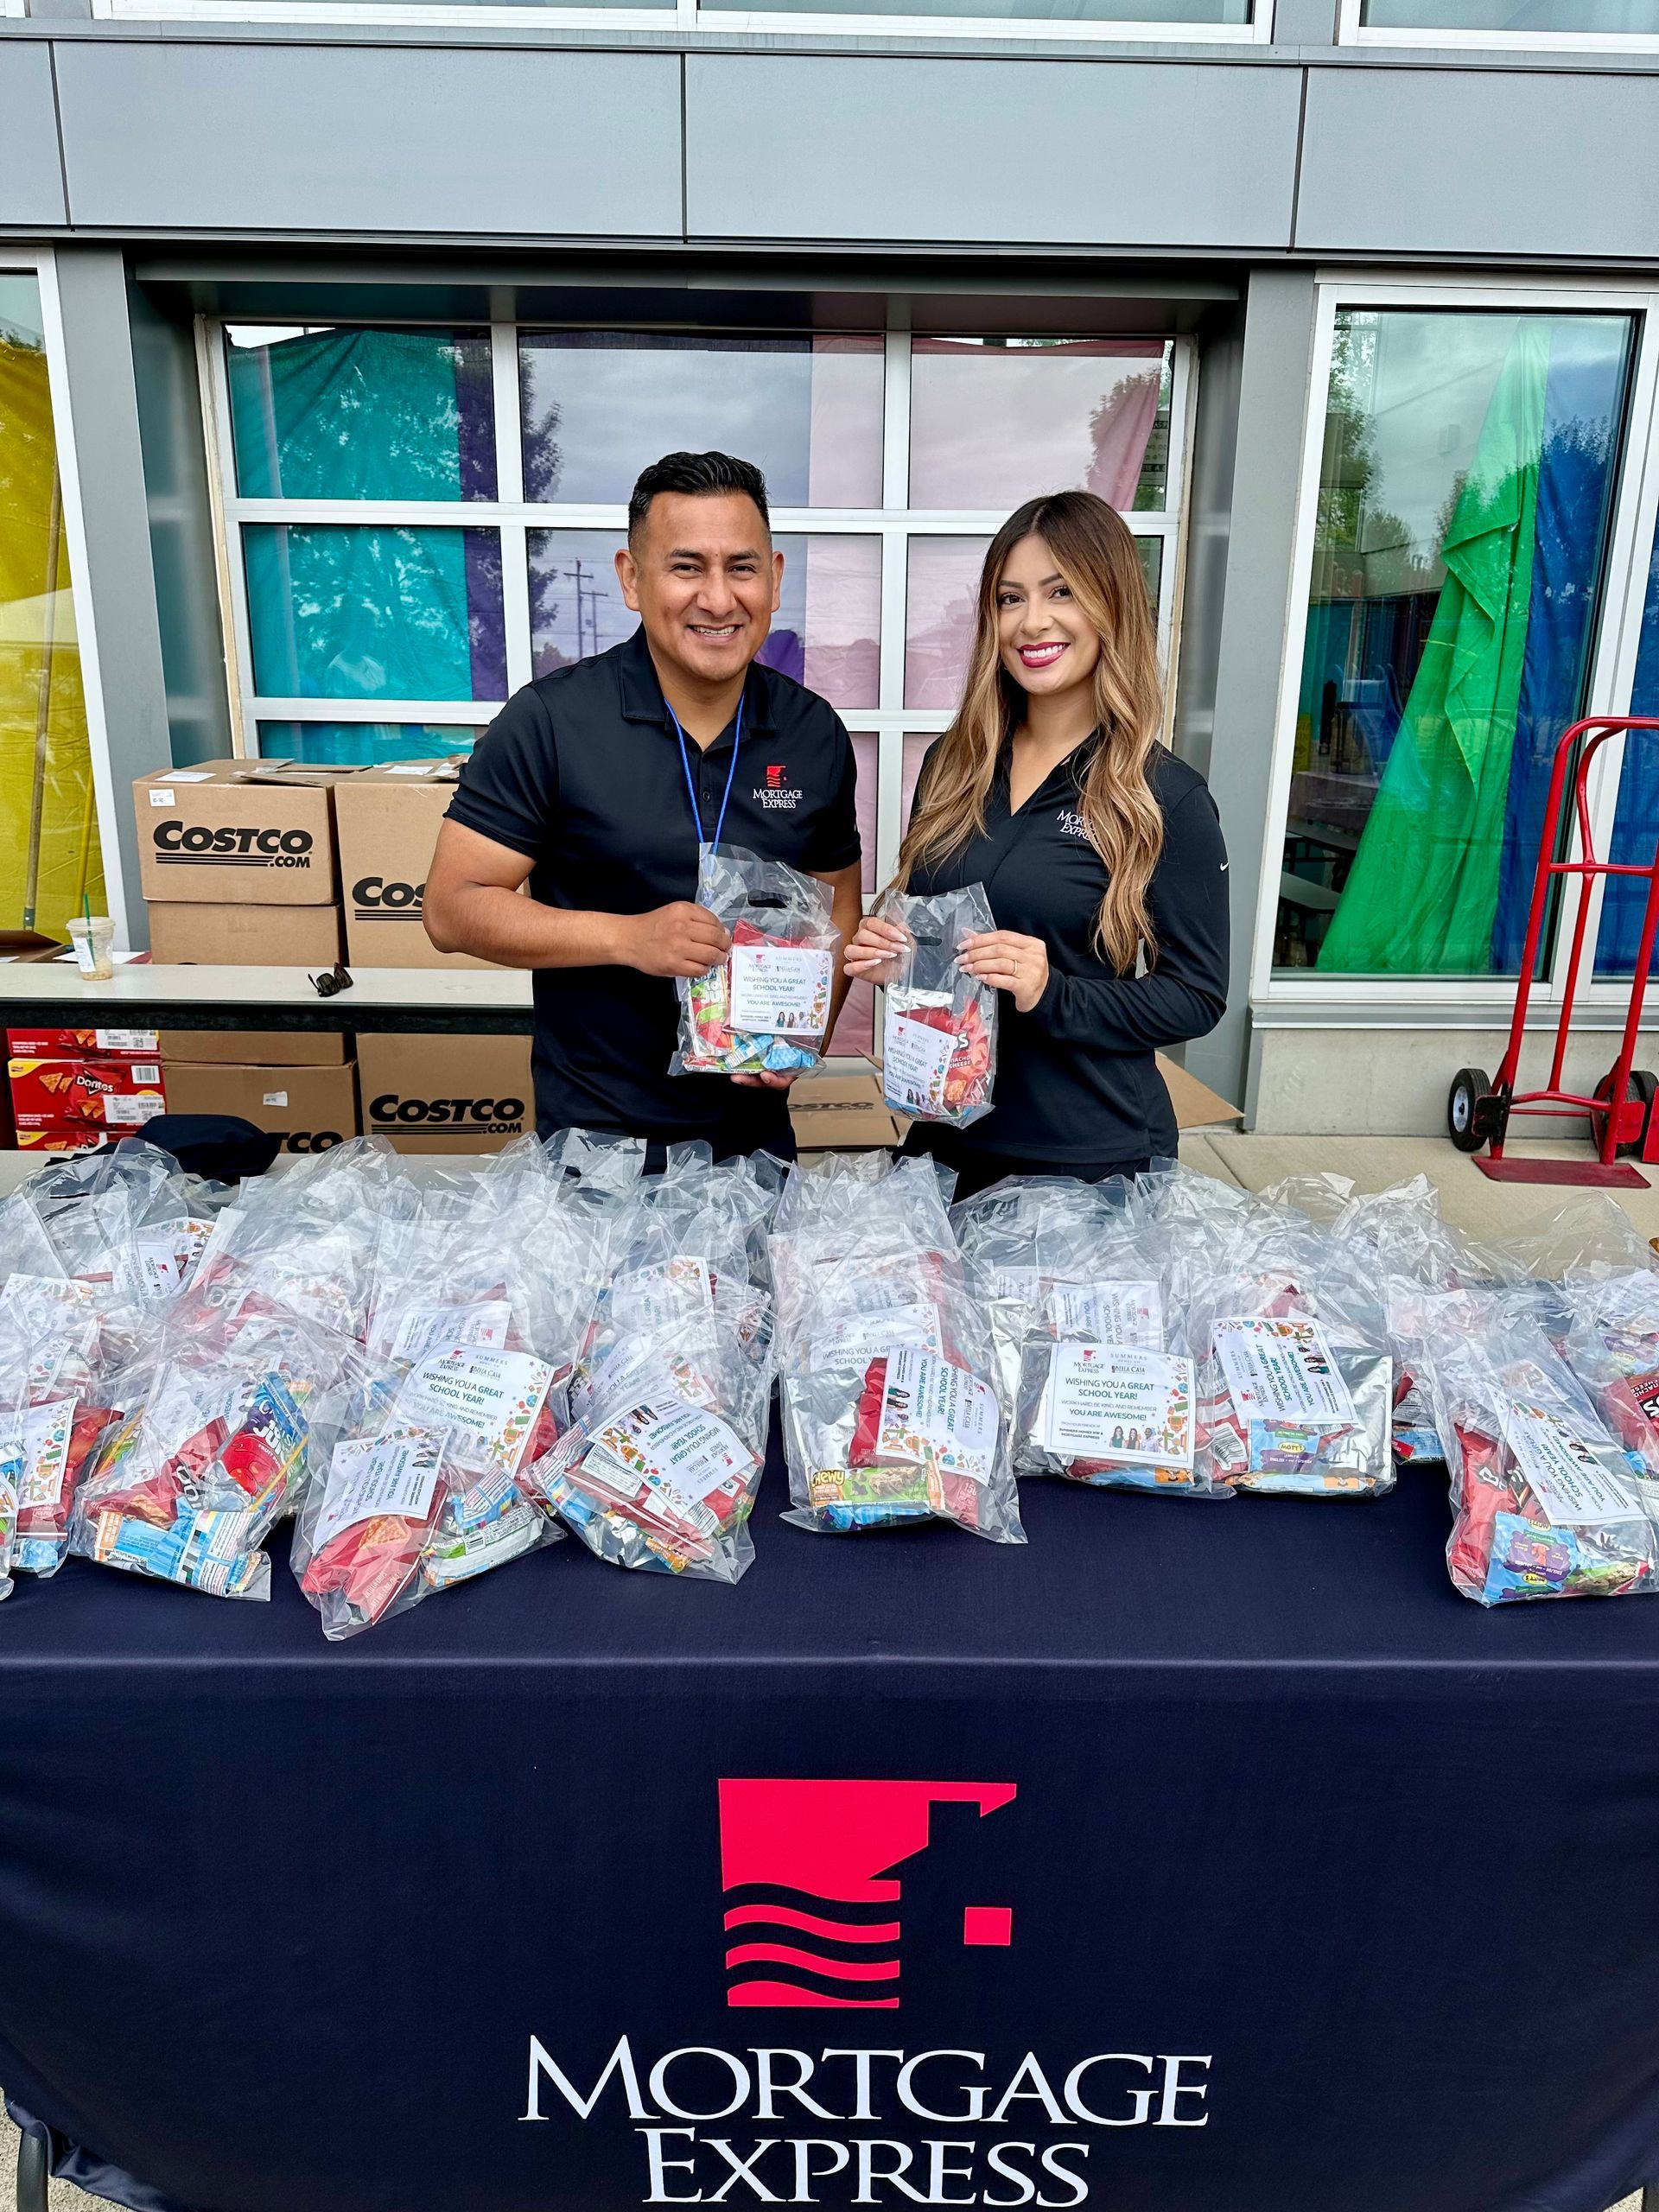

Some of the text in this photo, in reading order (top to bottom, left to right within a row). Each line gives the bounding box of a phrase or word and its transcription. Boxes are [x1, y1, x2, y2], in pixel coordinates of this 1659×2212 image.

[753, 789, 803, 798] MORTGAGE
[762, 798, 796, 808] EXPRESS
[153, 820, 314, 855] COSTCO
[270, 856, 310, 868] .COM
[369, 1094, 524, 1122] COSTCO
[482, 1122, 522, 1135] .COM
[265, 1131, 344, 1154] TCO
[1256, 1344, 1268, 1364] GREAT
[423, 1372, 454, 1385] WISHING
[454, 1379, 471, 1389] YOU
[478, 1386, 505, 1399] GREAT
[938, 1367, 948, 1414] SCHOOL YEAR!
[1065, 1377, 1100, 1388] WISHING
[1078, 1389, 1112, 1398] SCHOOL
[1278, 1376, 1292, 1401] SCHOOL
[429, 1383, 484, 1405] SCHOOL YEAR!
[916, 1385, 925, 1417] AWESOME!
[1103, 1412, 1147, 1421] AWESOME!
[670, 1450, 688, 1465] GREAT
[1558, 1465, 1583, 1497] SCHOOL
[517, 2034, 1213, 2127] MORTGAGE
[634, 2126, 1090, 2209] EXPRESS
